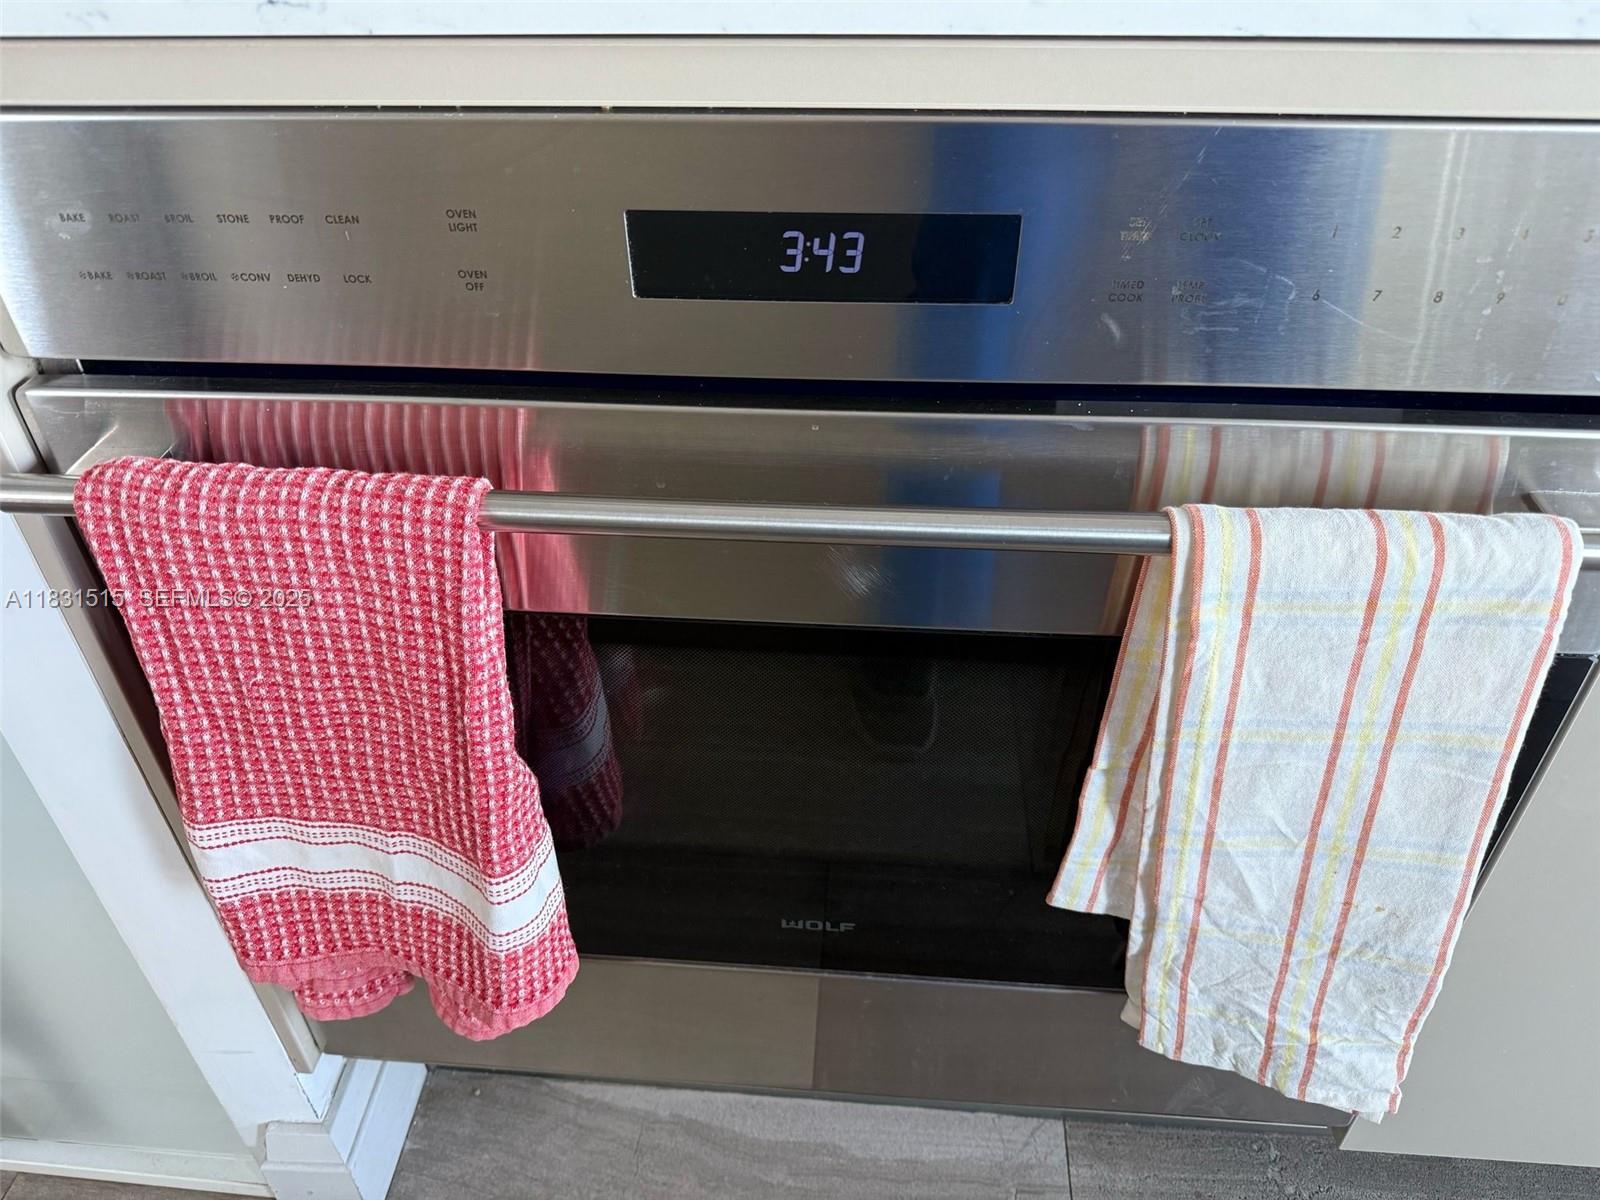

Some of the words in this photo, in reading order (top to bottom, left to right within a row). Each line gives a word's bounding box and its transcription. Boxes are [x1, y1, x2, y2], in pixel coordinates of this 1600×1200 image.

[58, 212, 86, 223] BAKE
[107, 213, 140, 223] ROAST
[164, 213, 195, 224] BROIL
[216, 213, 250, 224] STONE
[268, 214, 304, 224] PROOF
[445, 208, 477, 219] OVEN
[324, 214, 360, 225] CLEAN
[448, 222, 478, 232] LIGHT
[1331, 225, 1338, 239] 1
[1391, 226, 1402, 239] 2
[1455, 227, 1466, 240] 3
[1583, 229, 1595, 243] 5
[779, 230, 865, 274] 3:43
[88, 271, 113, 280] BAKE
[134, 271, 167, 281] ROAST
[188, 272, 218, 282] BROIL
[240, 272, 271, 282] CONV
[287, 273, 321, 283] DEHYD
[343, 274, 372, 284] LOCK
[457, 269, 488, 279] OVEN
[465, 282, 484, 291] OFF
[1108, 293, 1144, 302] COOK
[1311, 287, 1321, 301] 6
[1372, 289, 1383, 301] 7
[1432, 290, 1444, 303] 8
[1495, 291, 1505, 304] 9
[781, 919, 856, 932] WOLF
